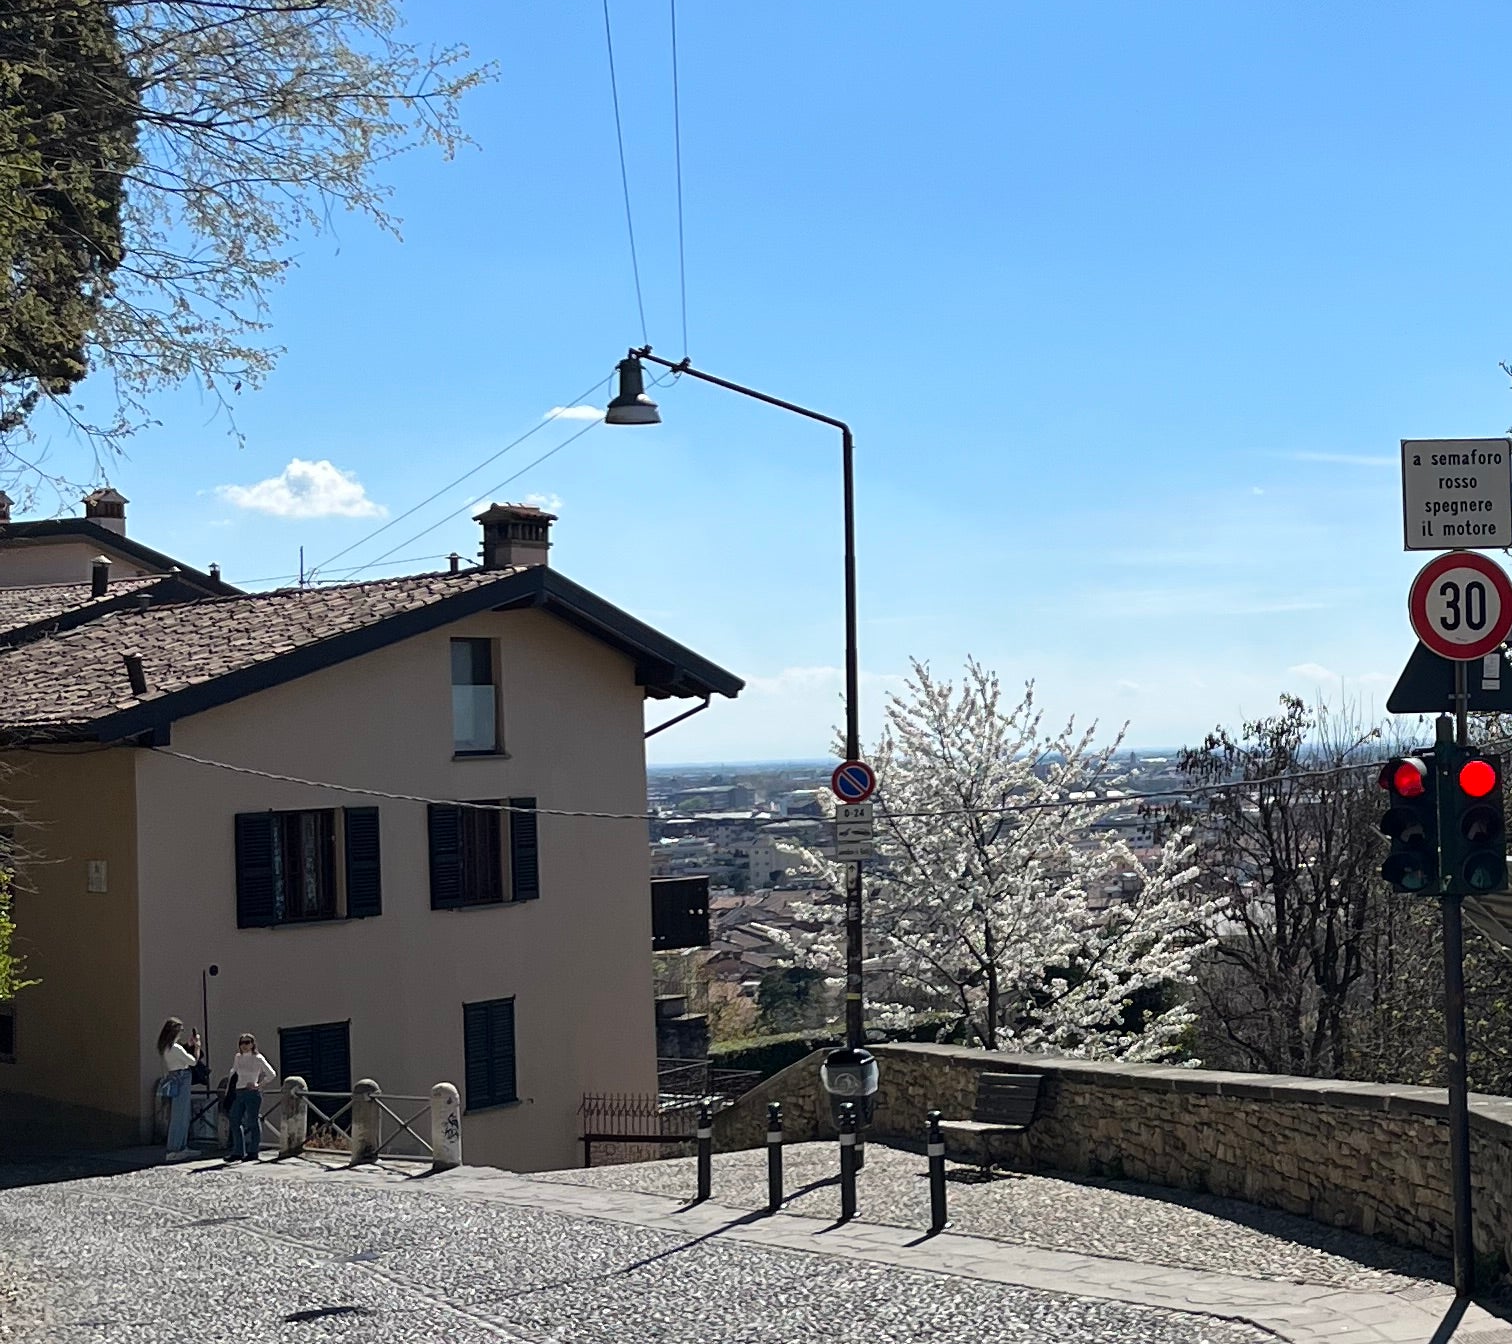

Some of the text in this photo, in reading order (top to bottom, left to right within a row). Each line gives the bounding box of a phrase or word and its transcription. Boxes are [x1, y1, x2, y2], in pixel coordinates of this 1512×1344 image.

[1413, 449, 1502, 466] a semaforo
[1439, 477, 1478, 489] rosso
[1425, 500, 1493, 516] spegnere
[1422, 520, 1497, 536] il motore
[1440, 581, 1486, 630] 30
